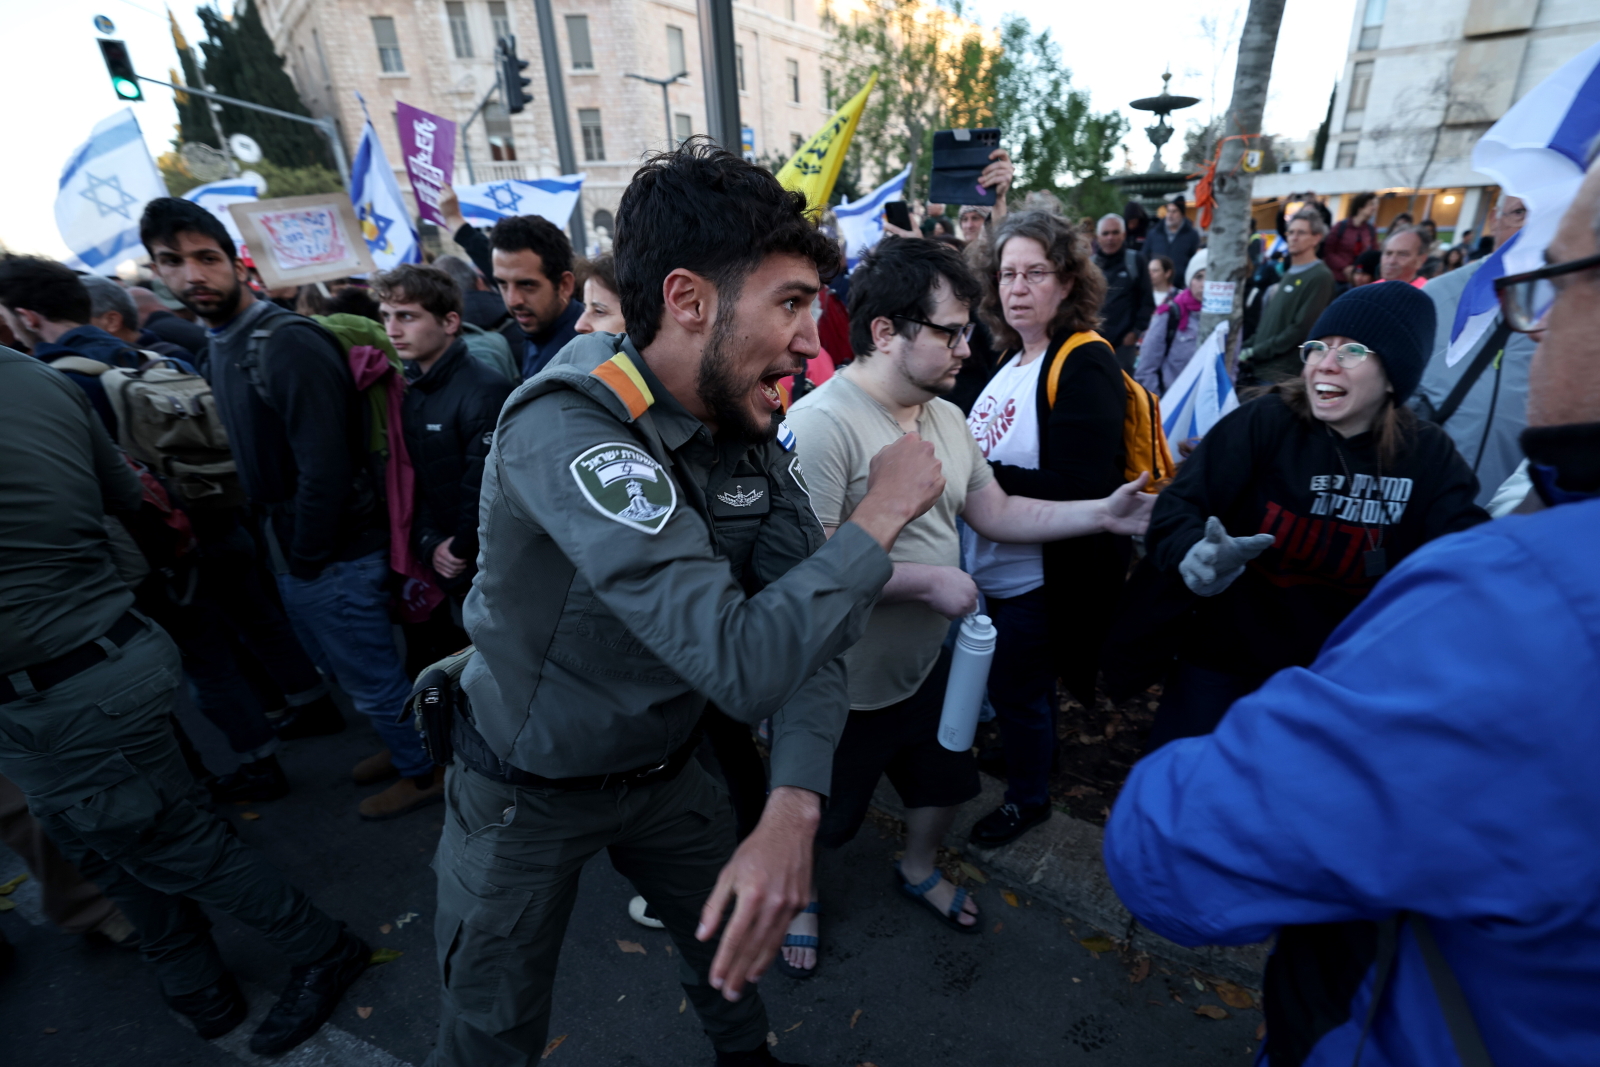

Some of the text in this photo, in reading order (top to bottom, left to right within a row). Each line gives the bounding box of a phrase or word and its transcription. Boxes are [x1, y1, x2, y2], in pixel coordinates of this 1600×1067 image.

[581, 450, 658, 471] משטרת ישראל
[1309, 491, 1363, 523] הביתה
